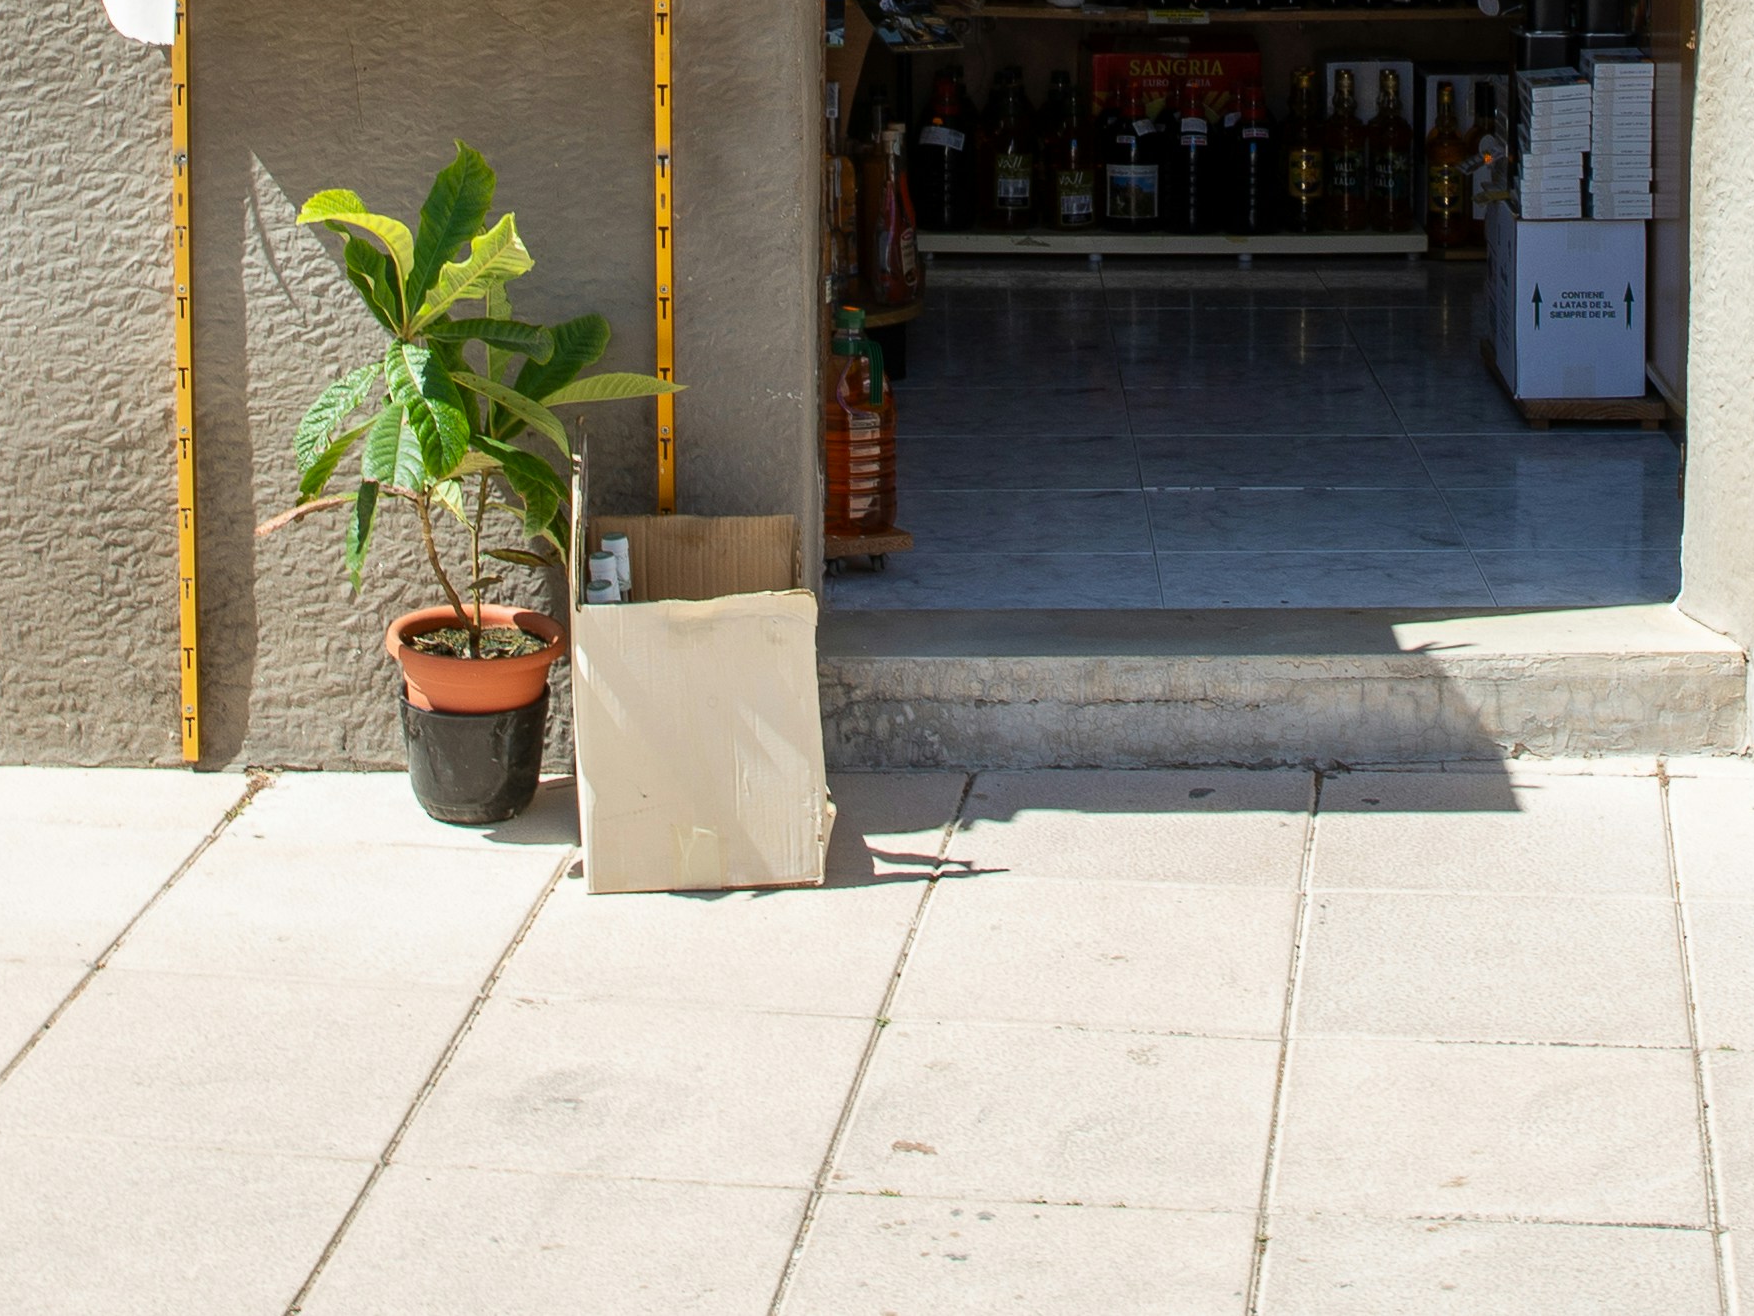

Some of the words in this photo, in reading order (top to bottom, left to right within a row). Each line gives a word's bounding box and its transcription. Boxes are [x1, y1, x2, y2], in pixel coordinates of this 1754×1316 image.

[1128, 59, 1224, 77] SANGRIA
[1561, 291, 1605, 299] CONTIENE
[1552, 301, 1558, 309] 4
[1559, 301, 1587, 309] LATAS
[1589, 301, 1598, 309] DE
[1599, 301, 1613, 309] 3L
[1549, 310, 1587, 318] SIEMPRE
[1589, 310, 1600, 318] DE
[1602, 310, 1616, 318] PIE
